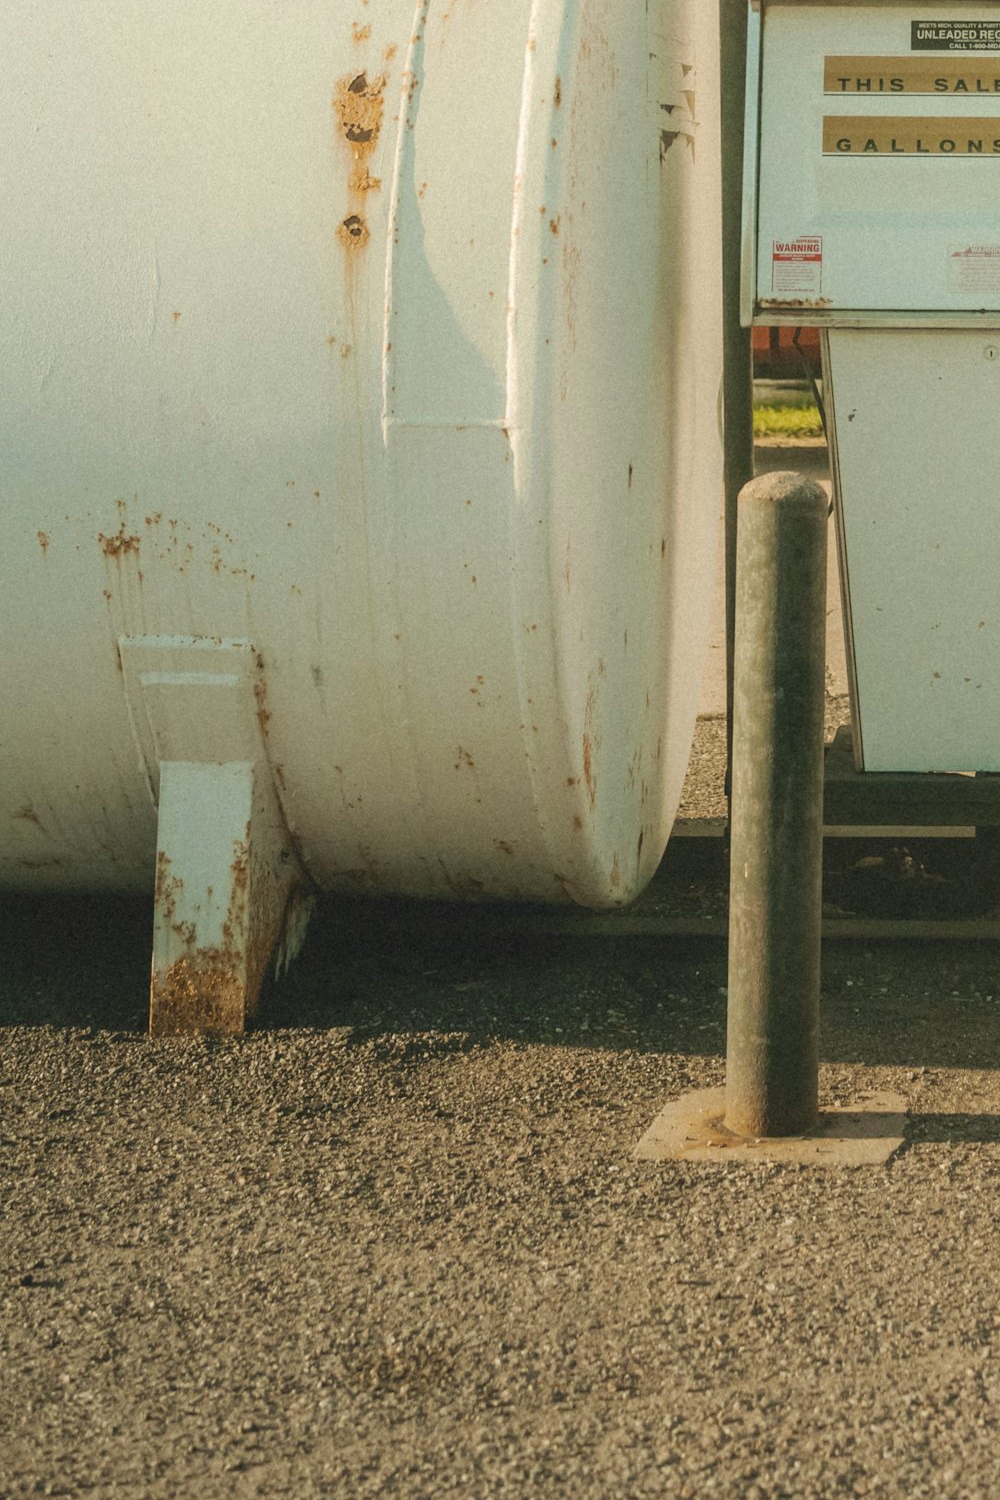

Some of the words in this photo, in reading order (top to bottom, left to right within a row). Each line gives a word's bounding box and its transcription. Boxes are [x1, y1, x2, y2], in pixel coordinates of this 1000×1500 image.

[917, 30, 977, 40] UNLEADED
[949, 42, 967, 50] CALL
[837, 78, 905, 92] THIS
[775, 243, 820, 252] WARNING
